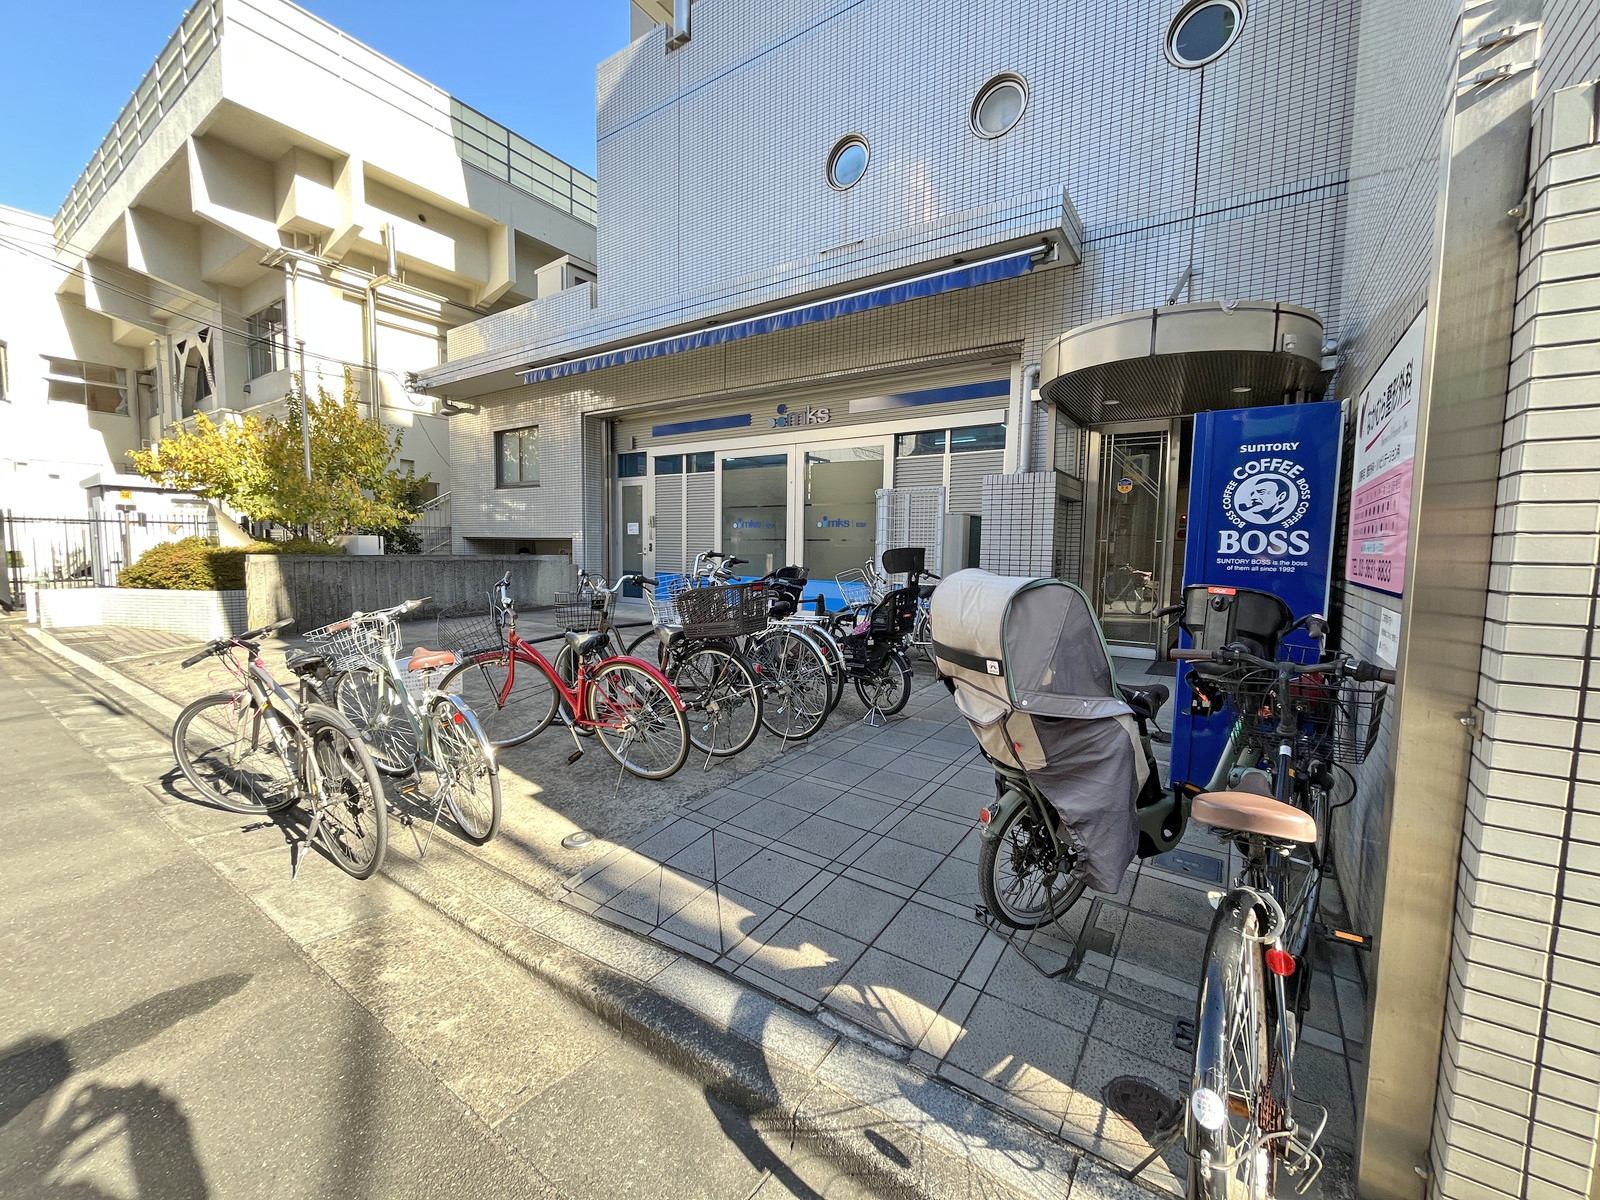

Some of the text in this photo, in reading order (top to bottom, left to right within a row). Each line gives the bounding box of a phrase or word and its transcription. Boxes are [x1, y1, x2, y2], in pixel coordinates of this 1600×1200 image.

[1240, 441, 1300, 453] SUNTORY
[1233, 458, 1304, 480] COFFEE
[1222, 480, 1246, 528] BOSS COFFEE
[1281, 478, 1311, 529] BOSS COFFEE
[1218, 529, 1310, 556] BOSS
